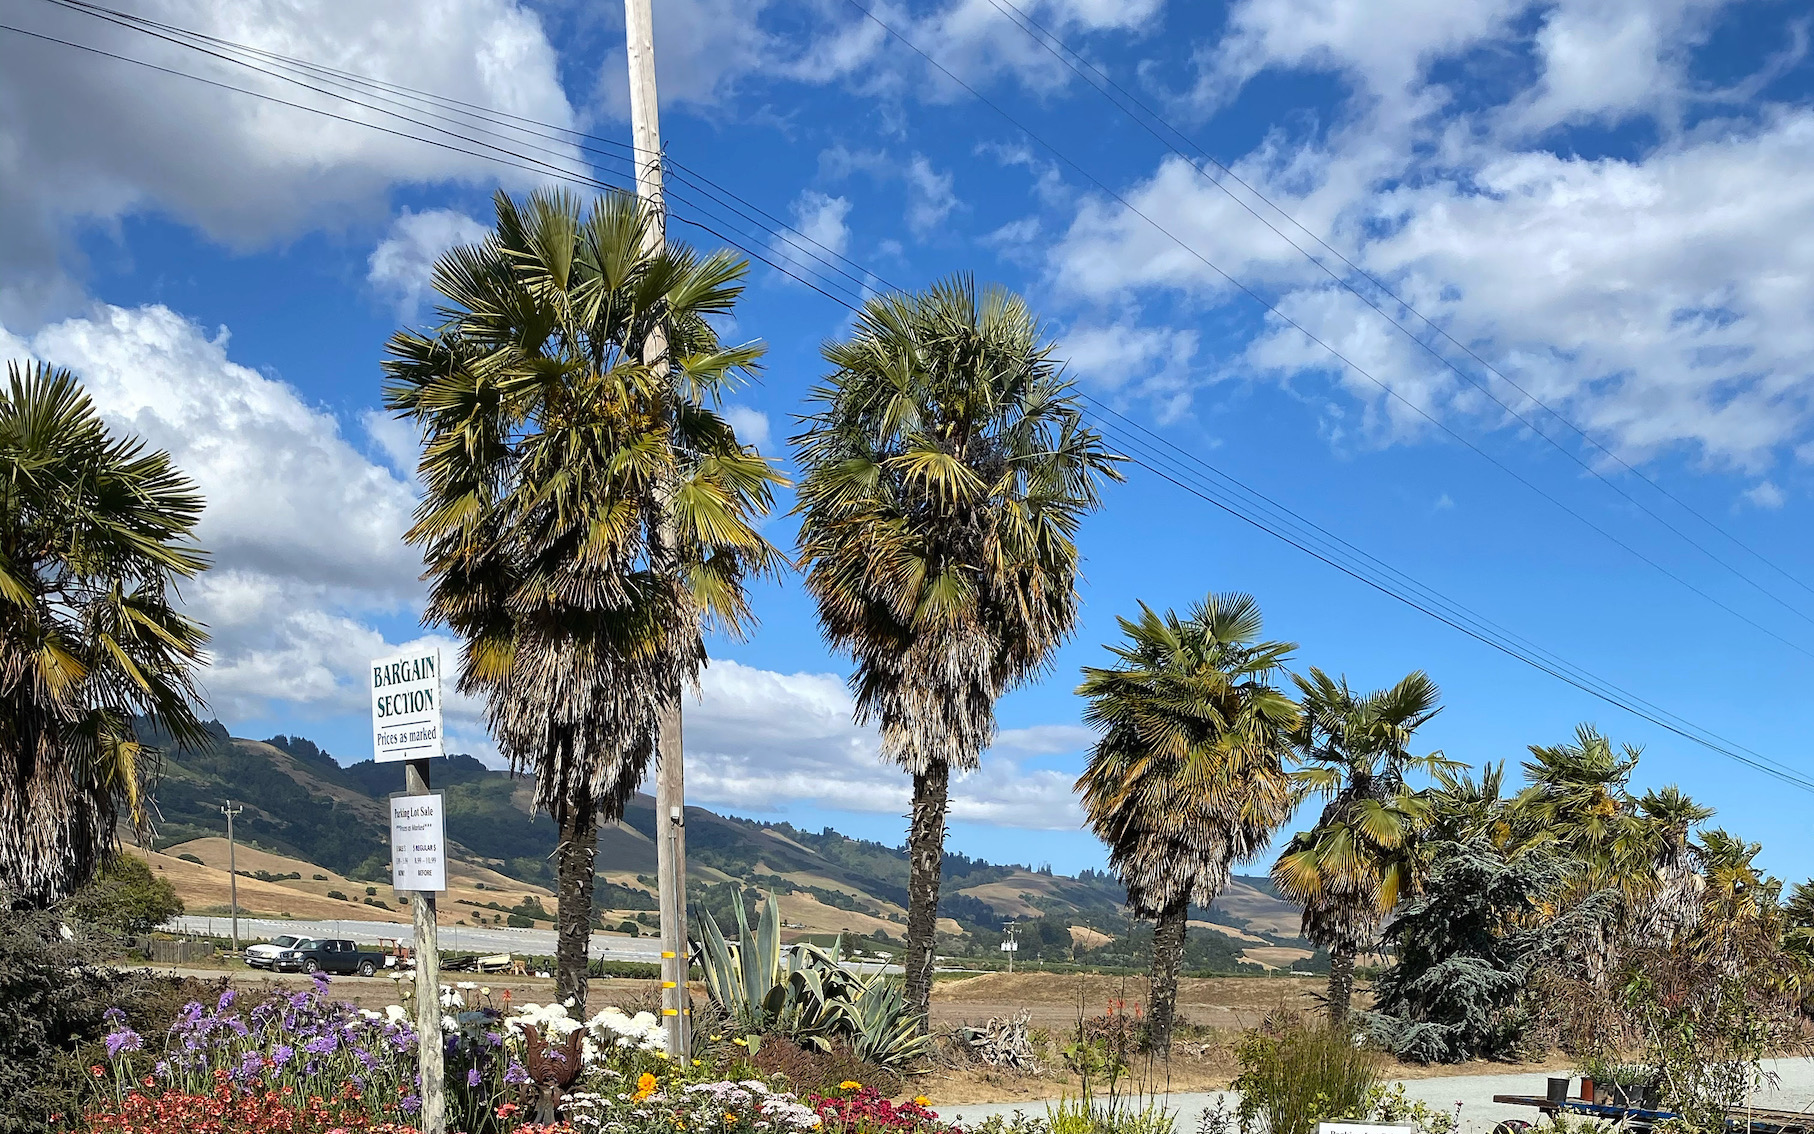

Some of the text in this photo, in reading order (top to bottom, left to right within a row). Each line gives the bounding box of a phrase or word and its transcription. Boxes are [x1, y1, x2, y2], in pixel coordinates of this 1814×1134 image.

[374, 656, 435, 688] BARGAIN
[377, 688, 434, 718] SECTION
[377, 726, 437, 746] Prices as marked
[394, 806, 434, 820] Parking Lot Sale
